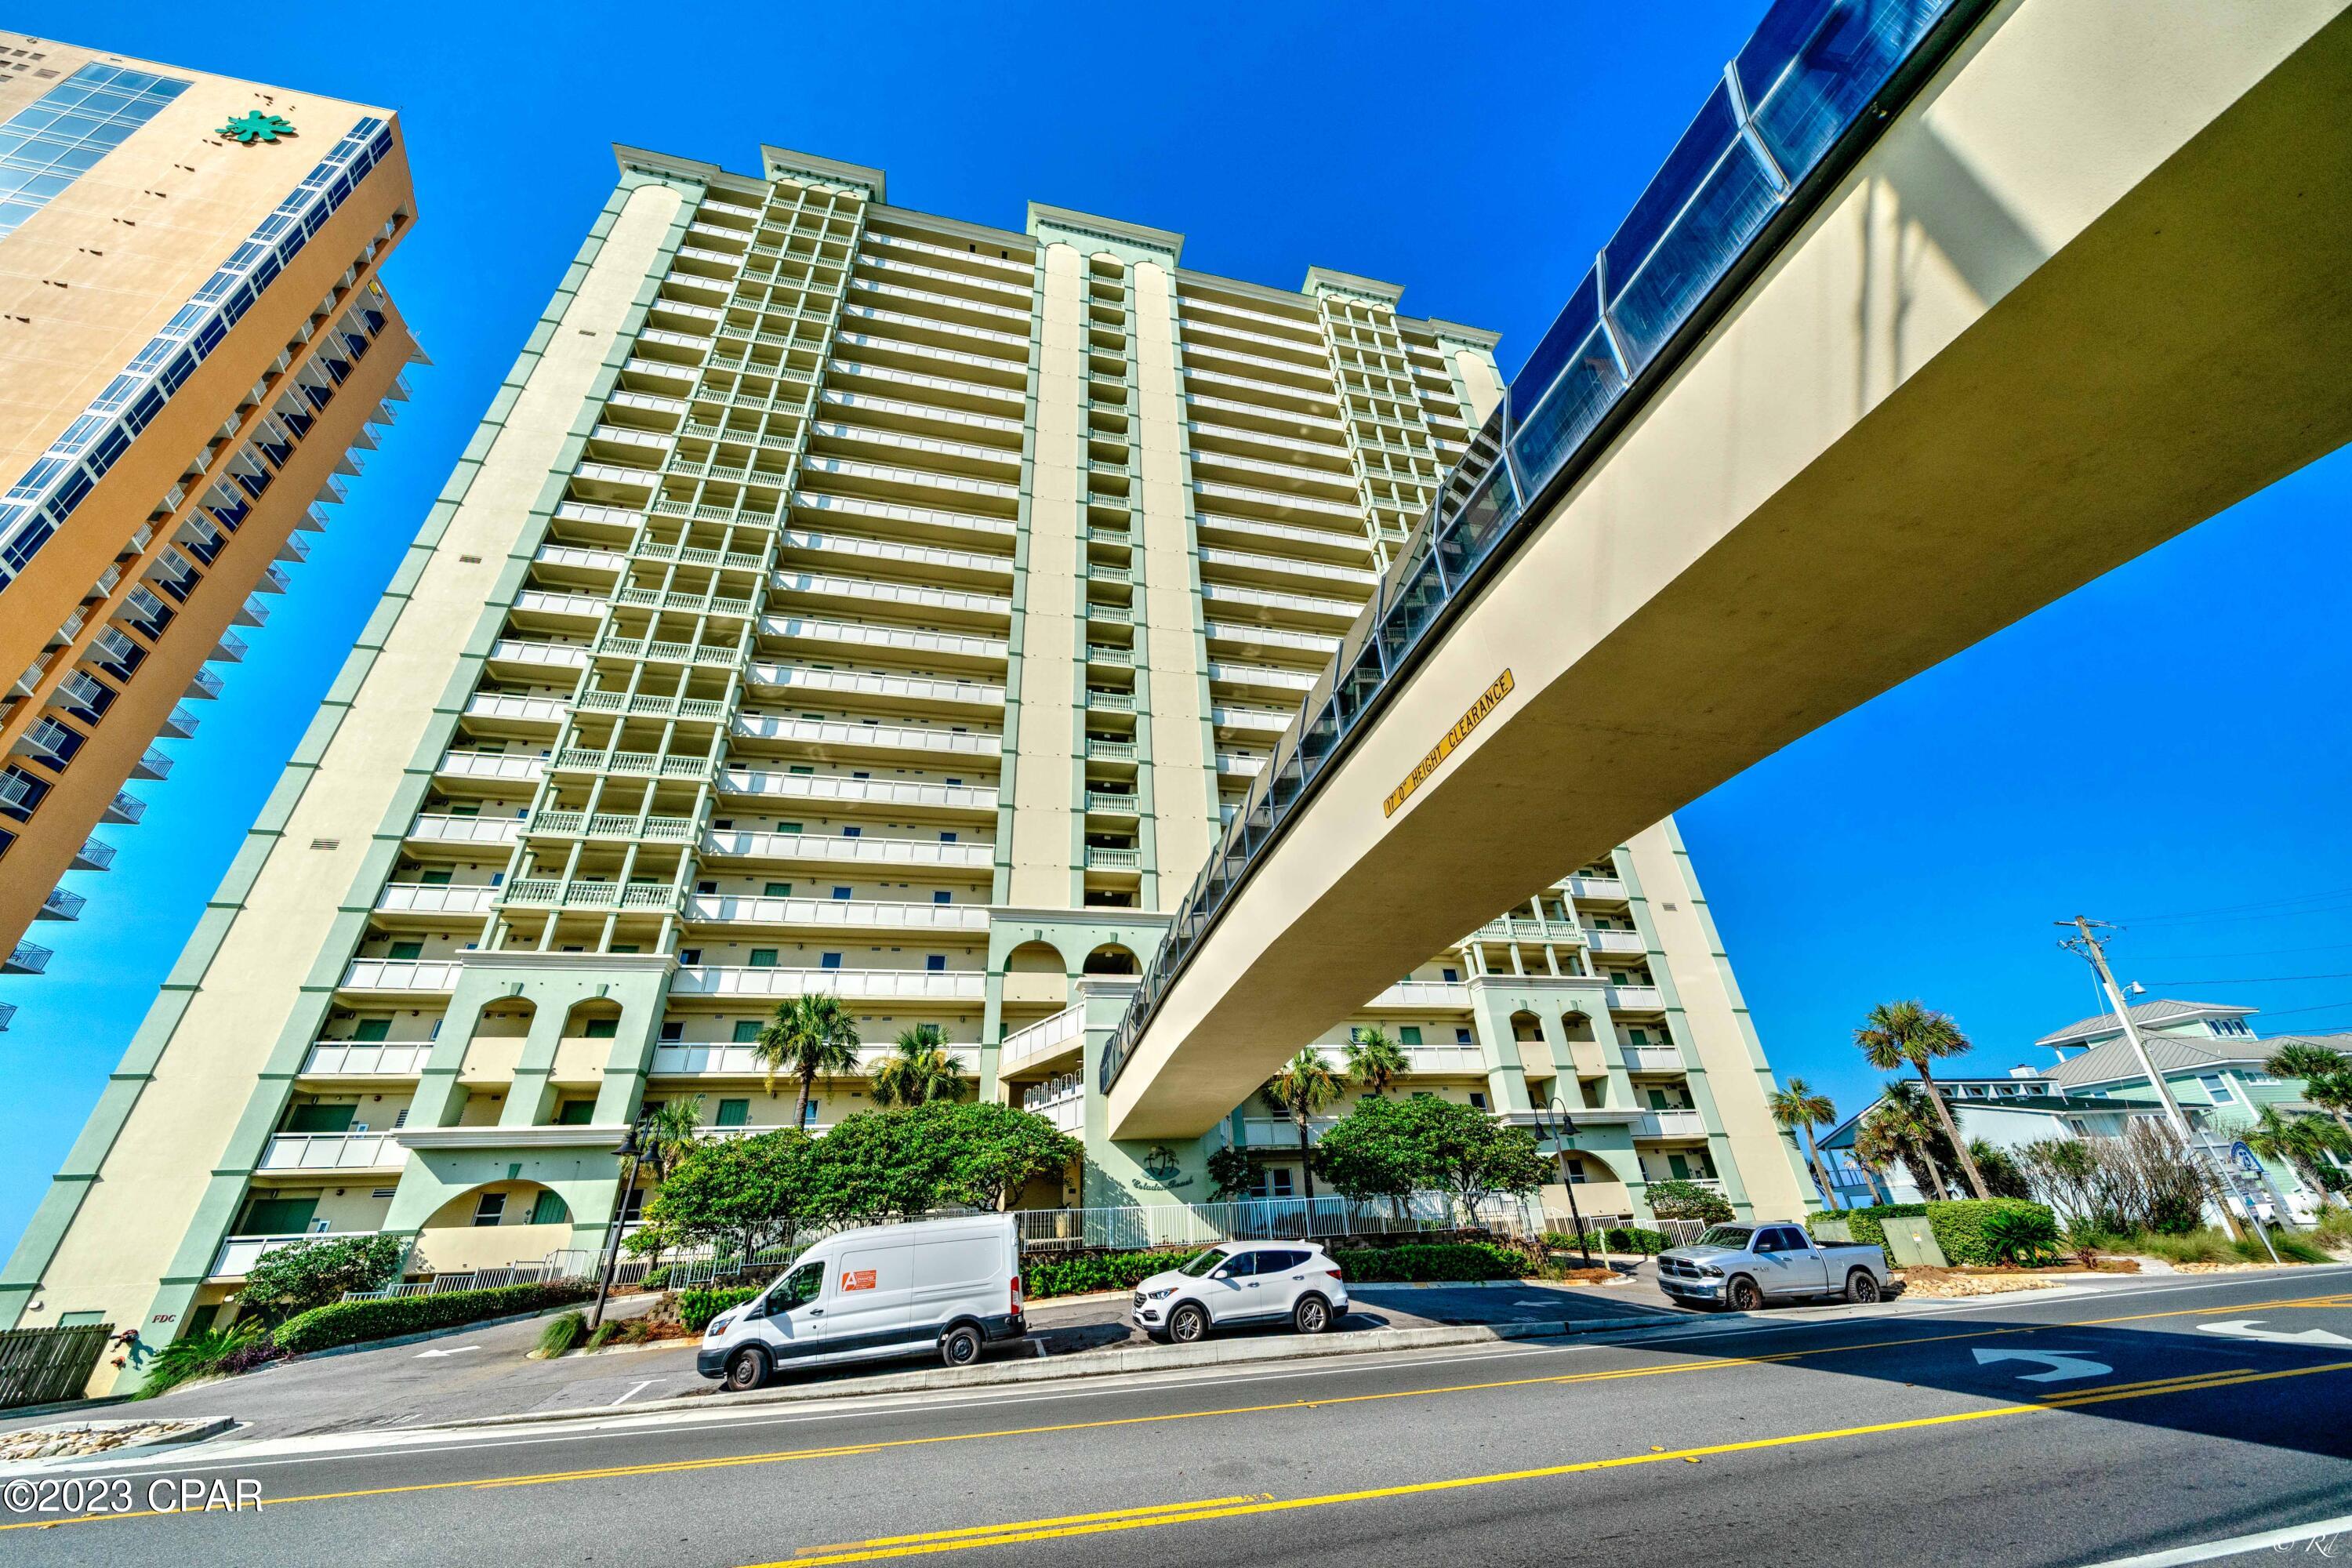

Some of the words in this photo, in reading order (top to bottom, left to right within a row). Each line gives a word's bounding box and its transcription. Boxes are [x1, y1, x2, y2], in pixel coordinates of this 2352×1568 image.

[1411, 746, 1443, 786] HEIGHT
[1448, 675, 1509, 748] CLEARANCE
[152, 1314, 176, 1323] FDC
